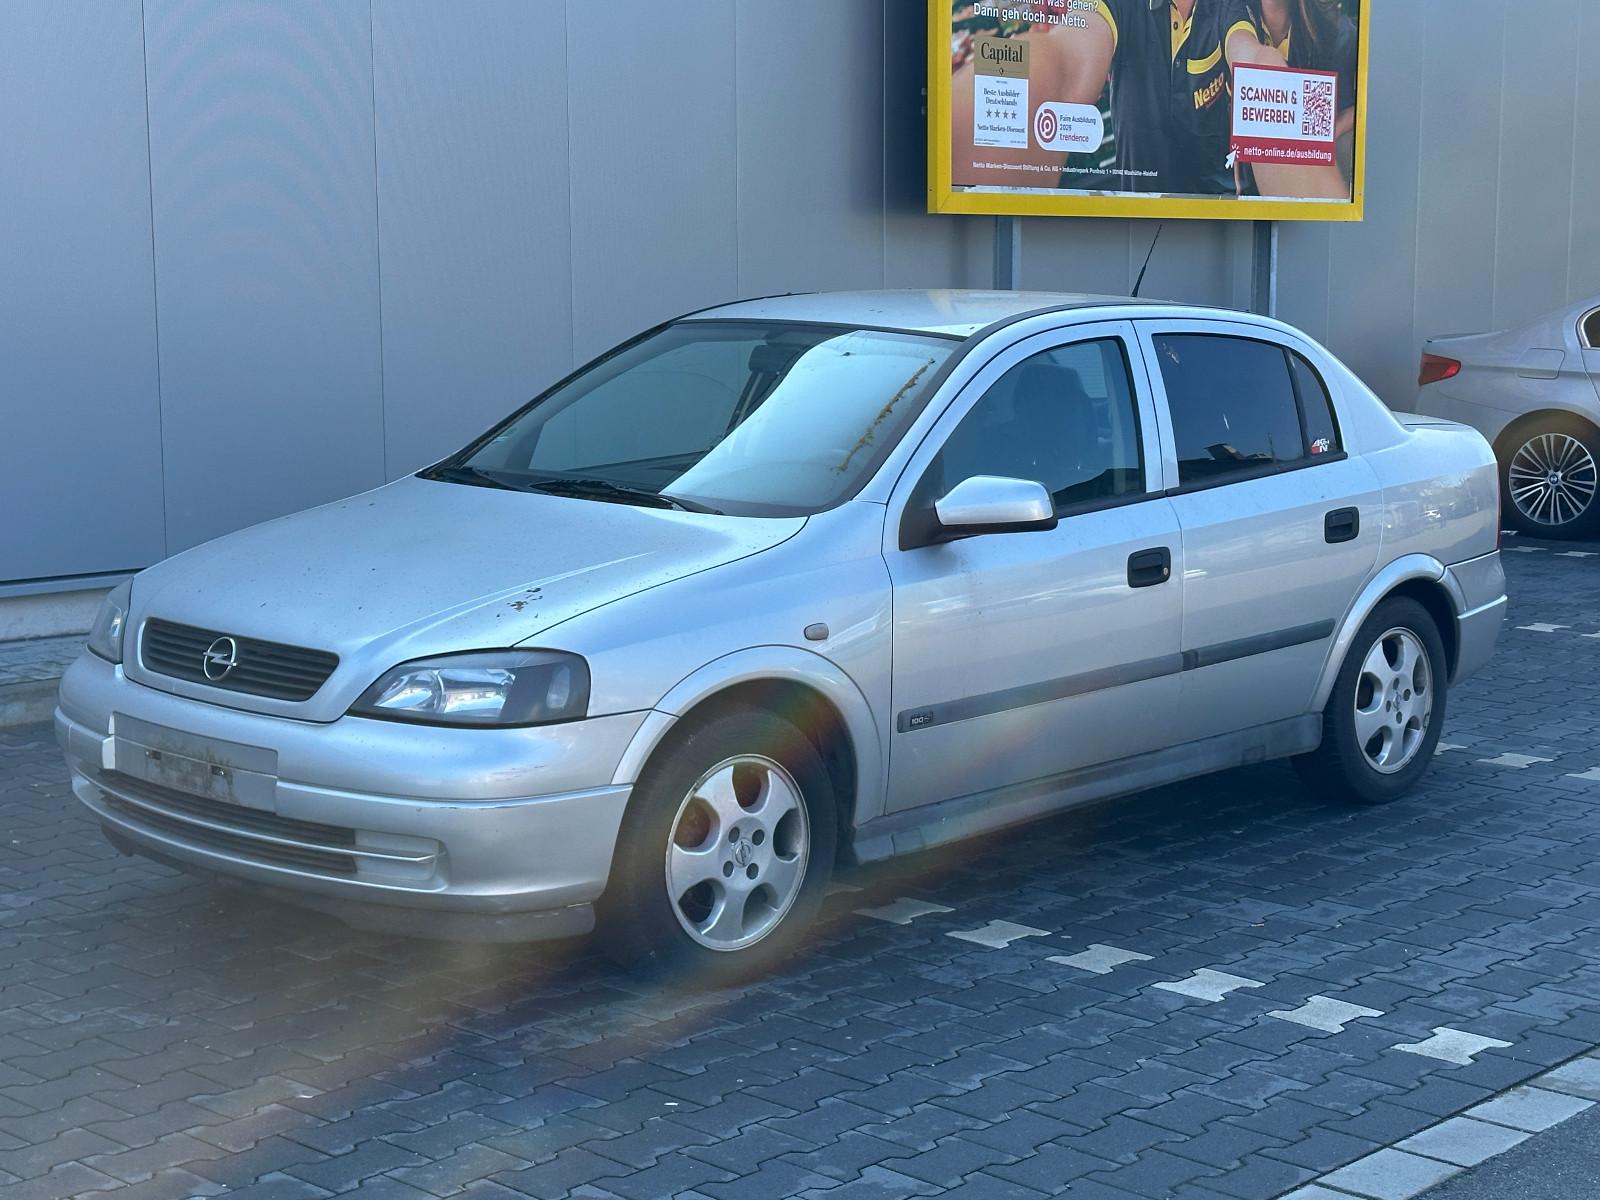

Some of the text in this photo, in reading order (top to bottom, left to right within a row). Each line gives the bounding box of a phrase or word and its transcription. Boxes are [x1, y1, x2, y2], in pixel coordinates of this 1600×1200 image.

[1067, 0, 1098, 12] gehen?
[973, 3, 999, 18] Dann
[1002, 8, 1020, 21] geh
[1022, 9, 1045, 23] doch
[1048, 15, 1058, 25] zu
[1061, 14, 1089, 28] Netto.
[981, 42, 1022, 64] Capital
[1193, 72, 1223, 109] Netto
[1240, 86, 1288, 104] SCANNEN
[1291, 91, 1297, 105] &
[1242, 107, 1295, 124] BEWERBEN
[1060, 133, 1089, 142] trendence
[1243, 147, 1332, 162] netto-online.de/ausbildung
